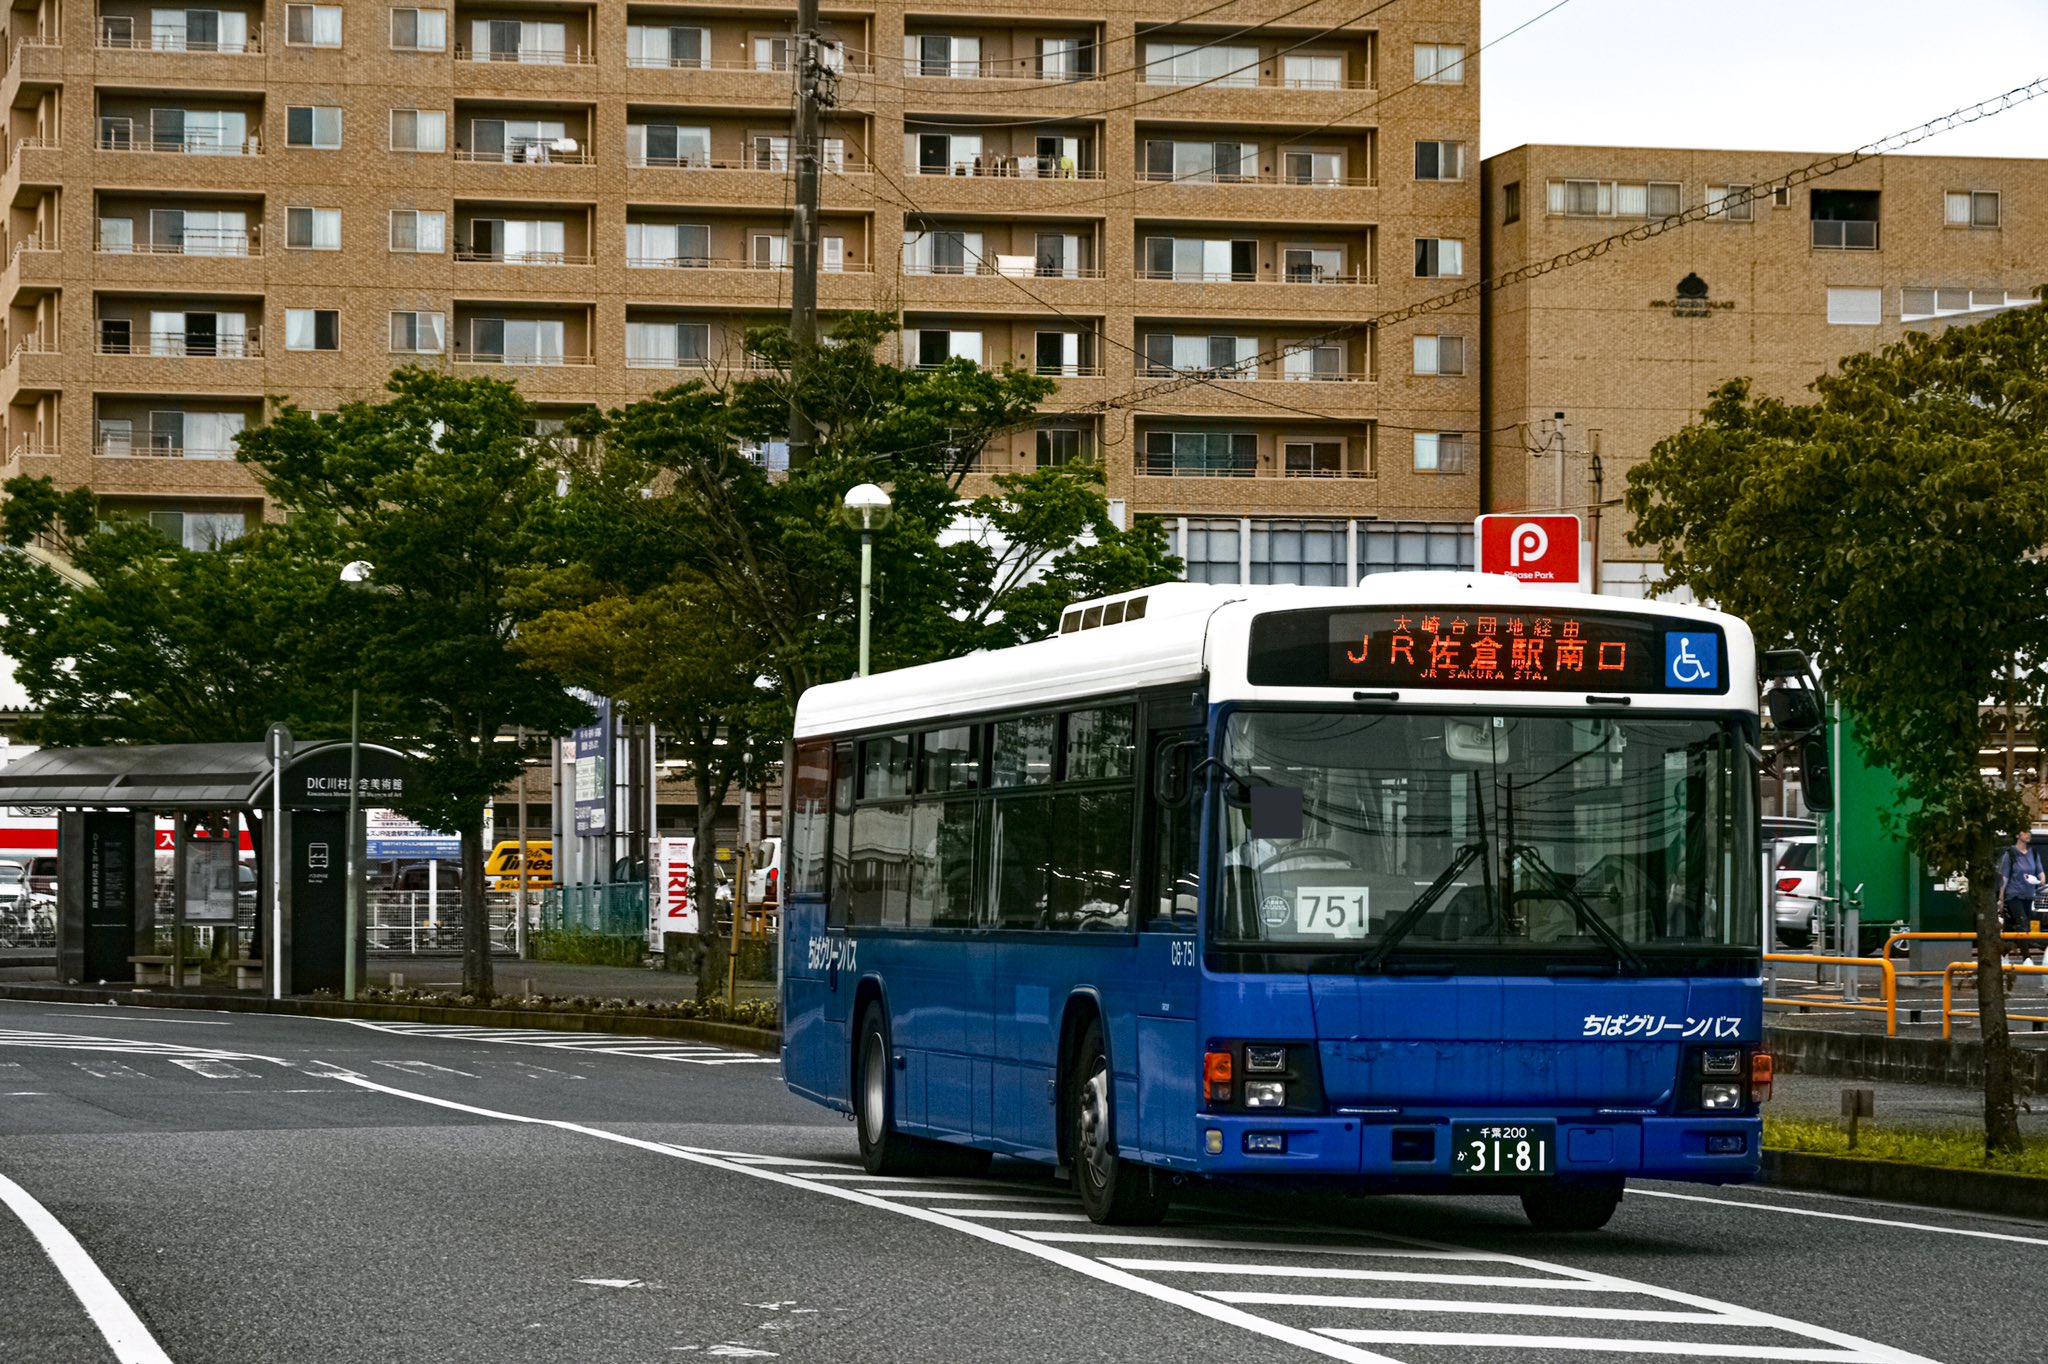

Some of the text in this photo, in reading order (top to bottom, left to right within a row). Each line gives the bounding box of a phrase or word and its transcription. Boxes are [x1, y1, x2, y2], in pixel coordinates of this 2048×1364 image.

[1534, 571, 1554, 579] Park
[1392, 614, 1580, 638] 大崎台団地経由
[1420, 669, 1548, 681] JR SAKURA STA.
[1301, 895, 1364, 928] 751
[808, 936, 857, 972] ちばグリーンバス
[1171, 941, 1196, 967] CG-751
[1582, 1014, 1742, 1038] ちばグリーンバス
[1457, 1140, 1545, 1172] か 31-81
